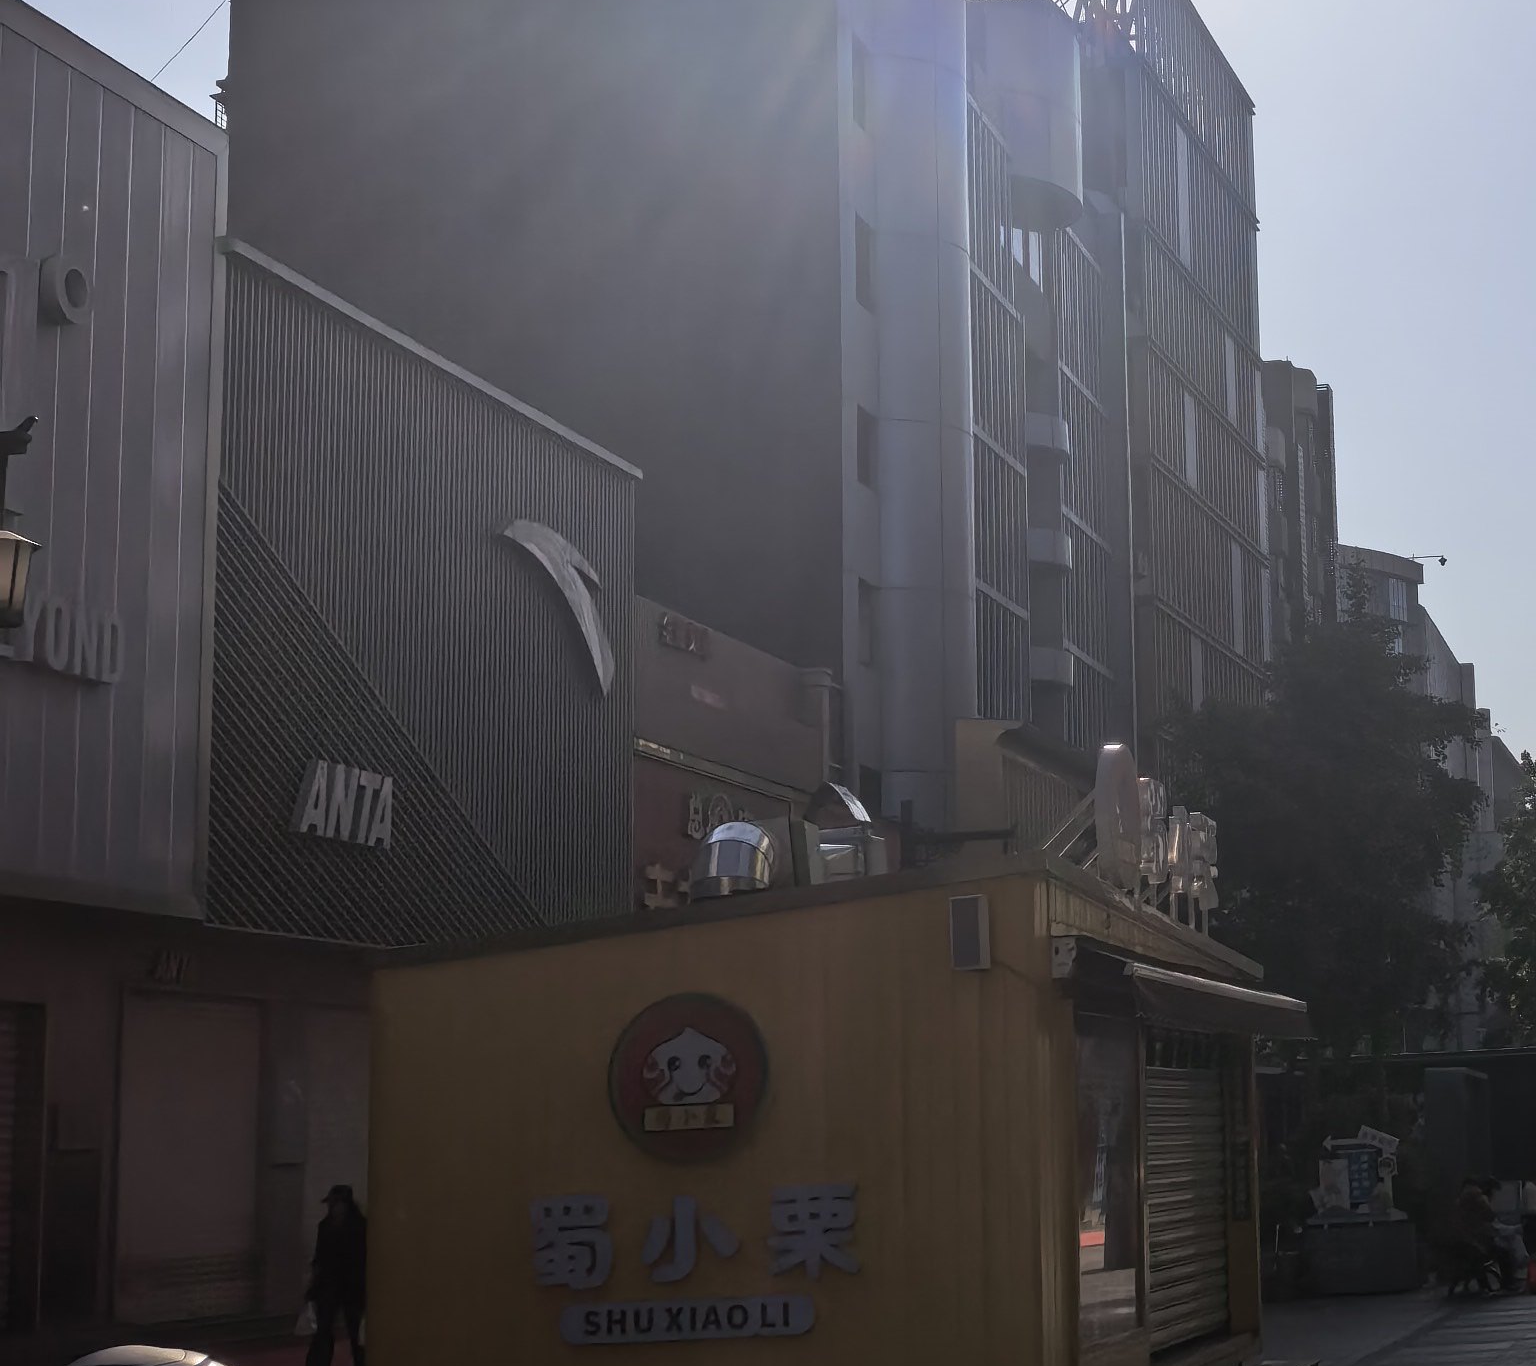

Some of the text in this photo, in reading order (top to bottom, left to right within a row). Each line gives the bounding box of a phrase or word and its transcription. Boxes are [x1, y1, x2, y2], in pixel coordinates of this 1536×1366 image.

[0, 590, 125, 684] YOND
[299, 761, 393, 849] ANTA
[530, 1181, 862, 1291] 蜀小栗
